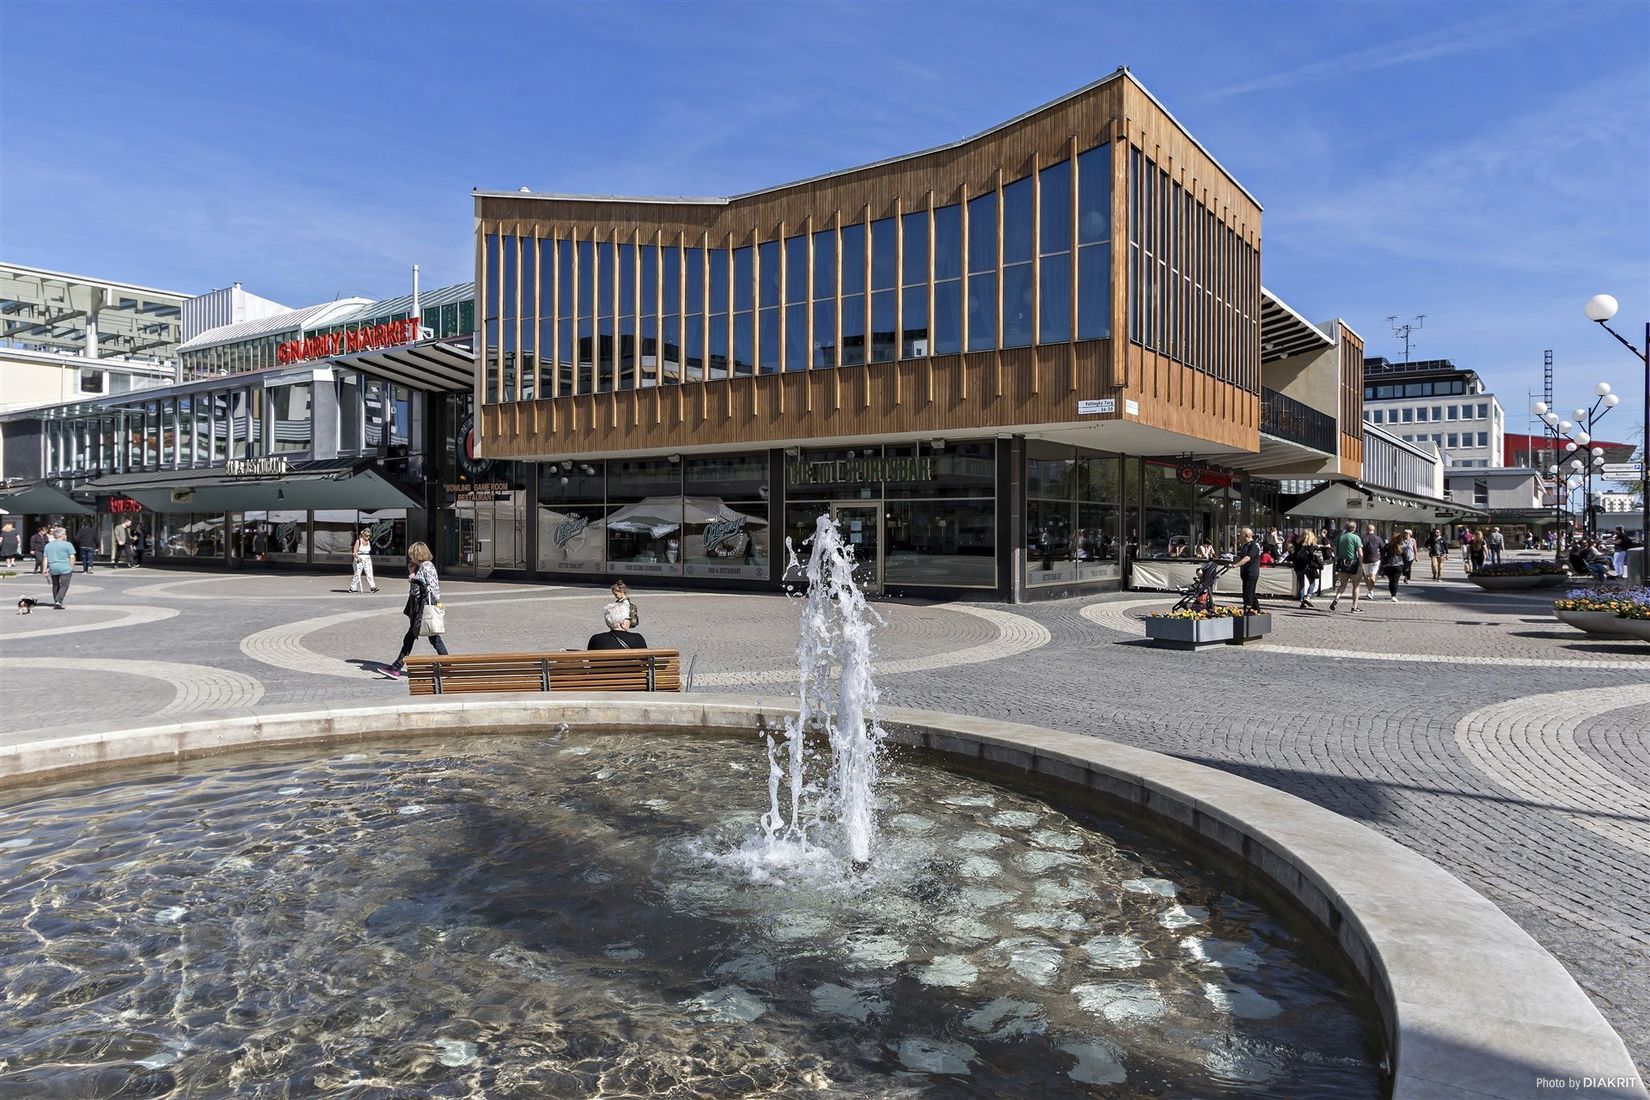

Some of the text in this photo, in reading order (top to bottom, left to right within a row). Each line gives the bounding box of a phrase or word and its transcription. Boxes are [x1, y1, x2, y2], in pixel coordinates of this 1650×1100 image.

[278, 317, 420, 363] GNARLY MARKET
[447, 484, 471, 492] BOWLING
[457, 493, 495, 501] RESTAURANT
